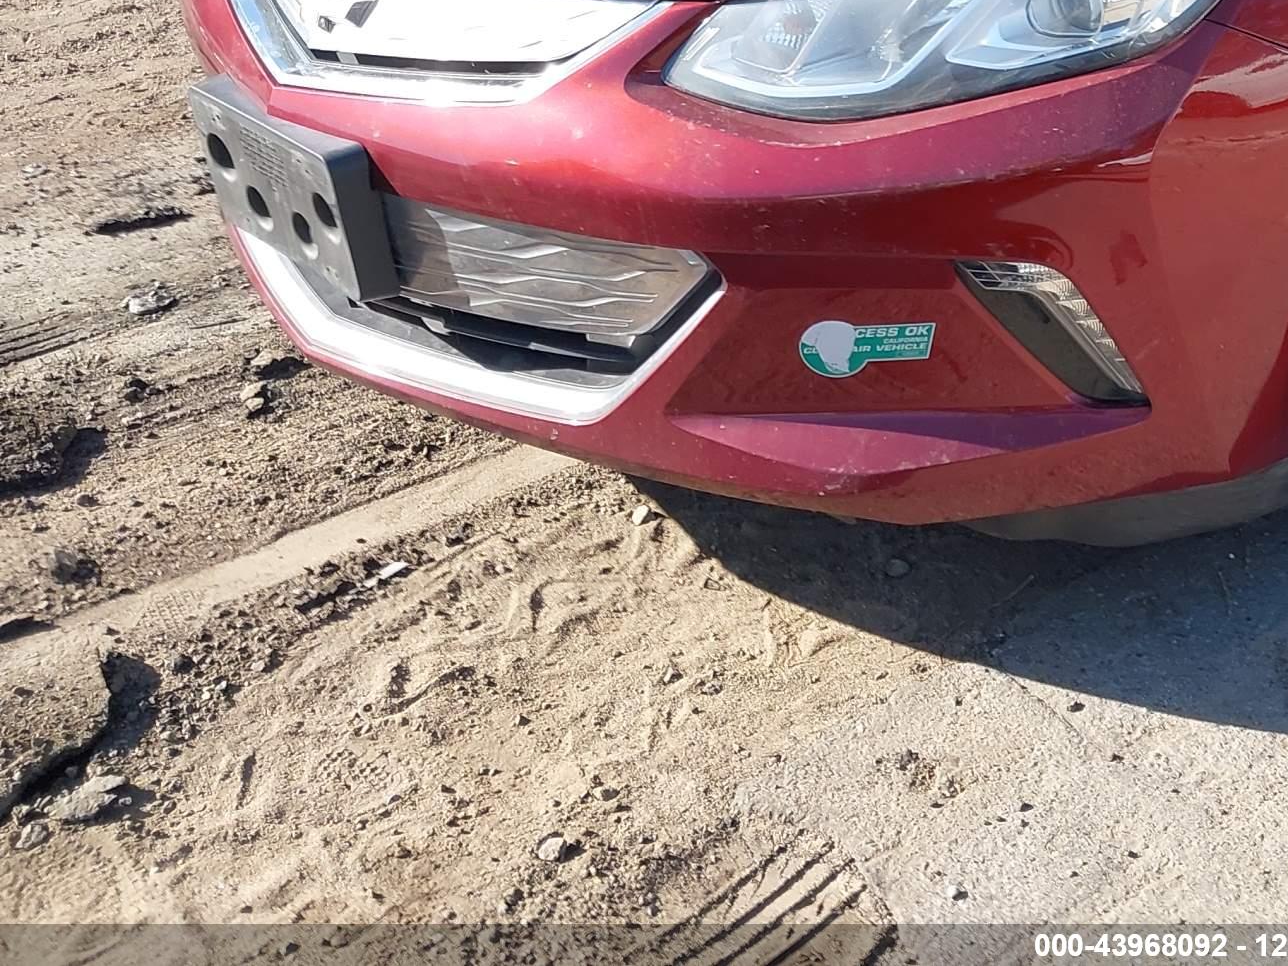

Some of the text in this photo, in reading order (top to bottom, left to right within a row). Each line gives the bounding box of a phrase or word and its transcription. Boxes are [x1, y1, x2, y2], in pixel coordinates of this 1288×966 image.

[855, 325, 930, 338] CESS OK
[876, 343, 928, 352] VEHICLE
